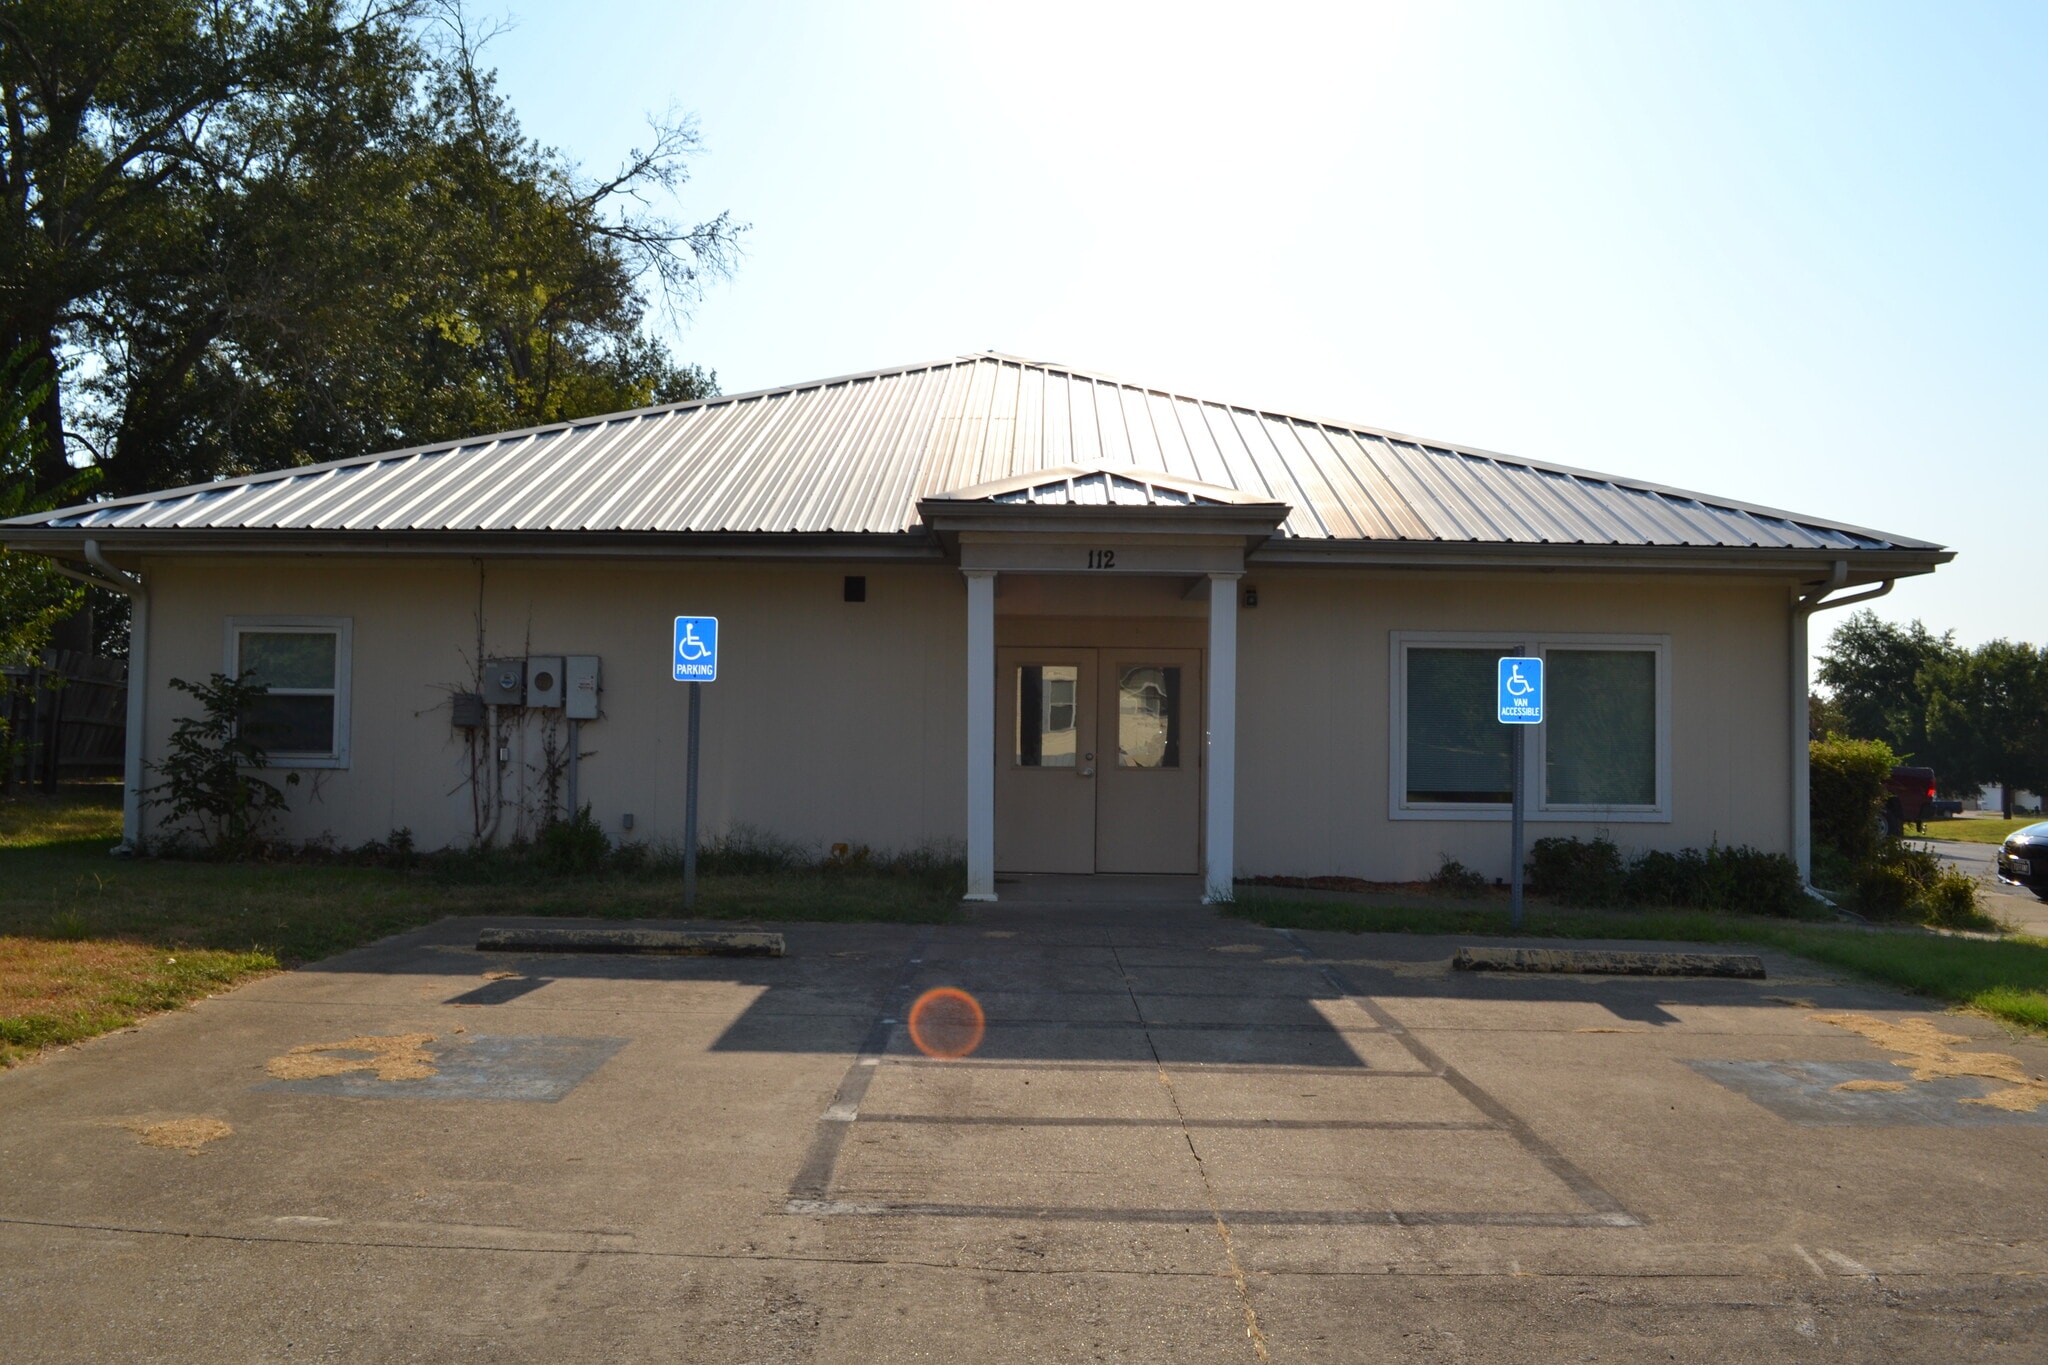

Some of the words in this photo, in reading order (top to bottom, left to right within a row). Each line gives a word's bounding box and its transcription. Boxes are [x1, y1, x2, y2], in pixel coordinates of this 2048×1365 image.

[1088, 550, 1115, 569] 112
[676, 663, 713, 675] PARKING
[1513, 698, 1528, 707] VAN
[1501, 707, 1540, 716] ACCESSIBLE
